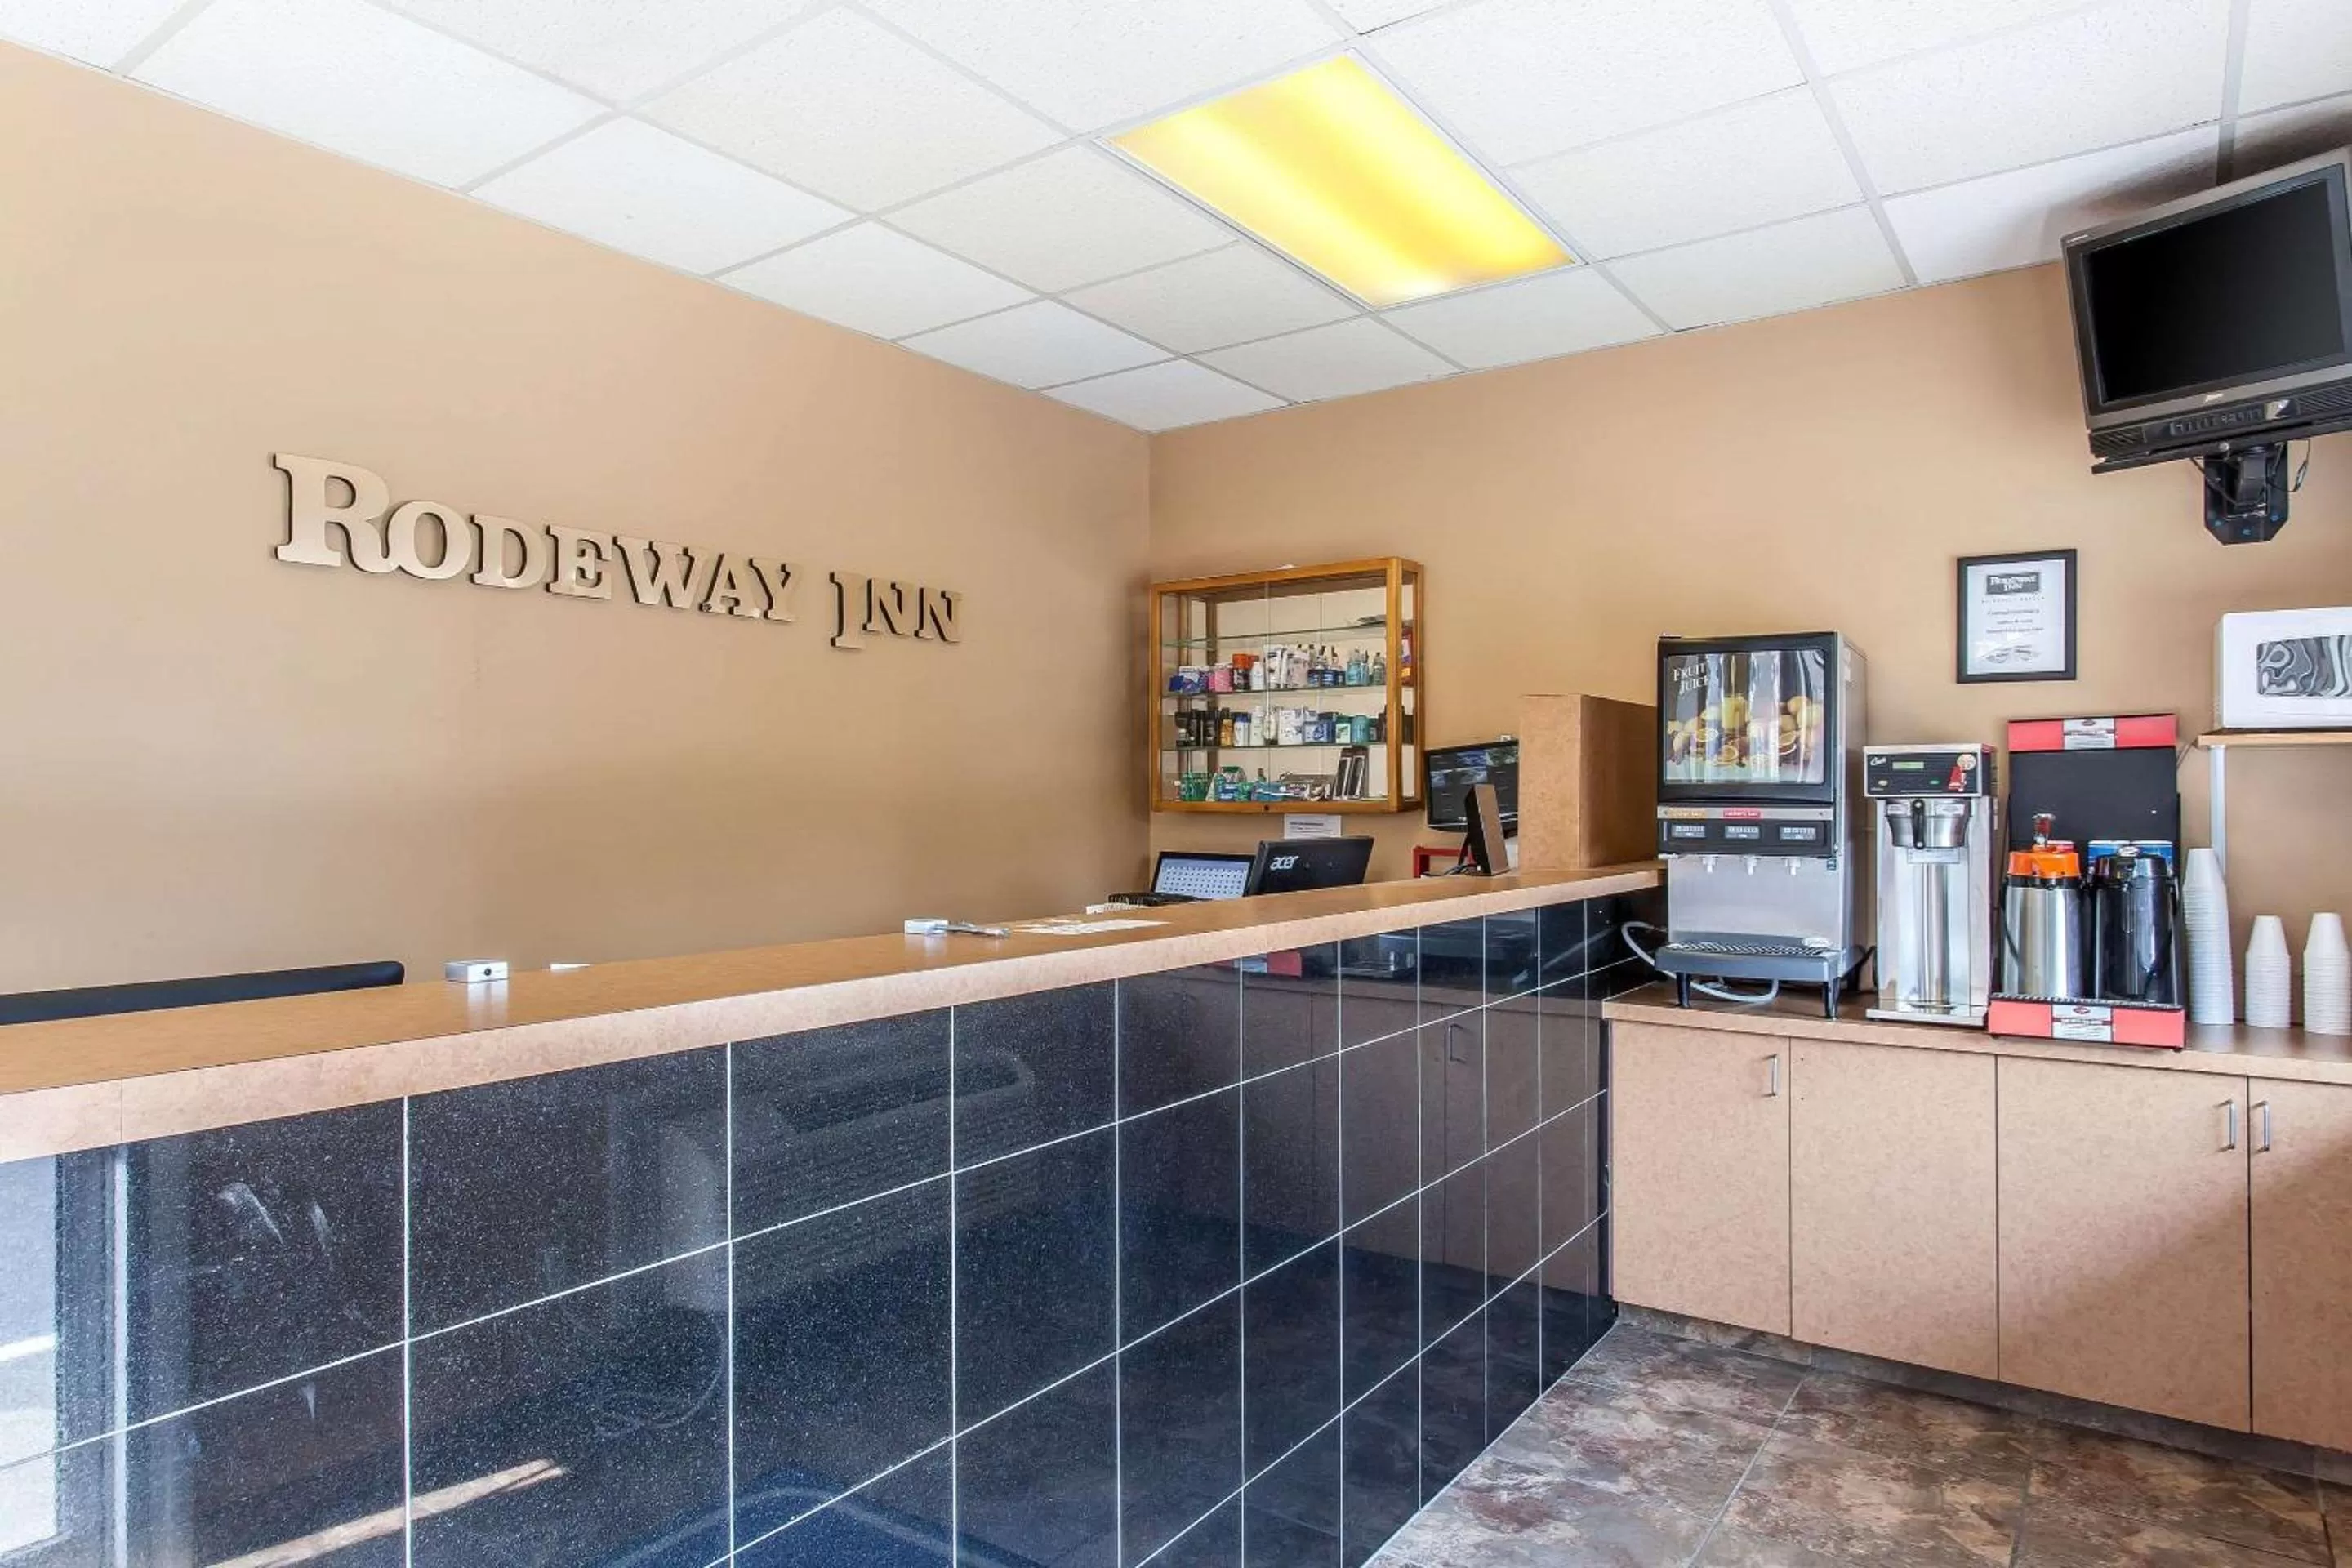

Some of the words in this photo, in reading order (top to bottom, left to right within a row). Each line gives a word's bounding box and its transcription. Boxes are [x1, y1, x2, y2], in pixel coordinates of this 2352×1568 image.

[272, 452, 802, 622] RODEWAY
[830, 571, 963, 649] INN
[1673, 662, 1707, 682] FRUIT
[1679, 675, 1709, 695] JUICE
[1270, 855, 1299, 871] acer
